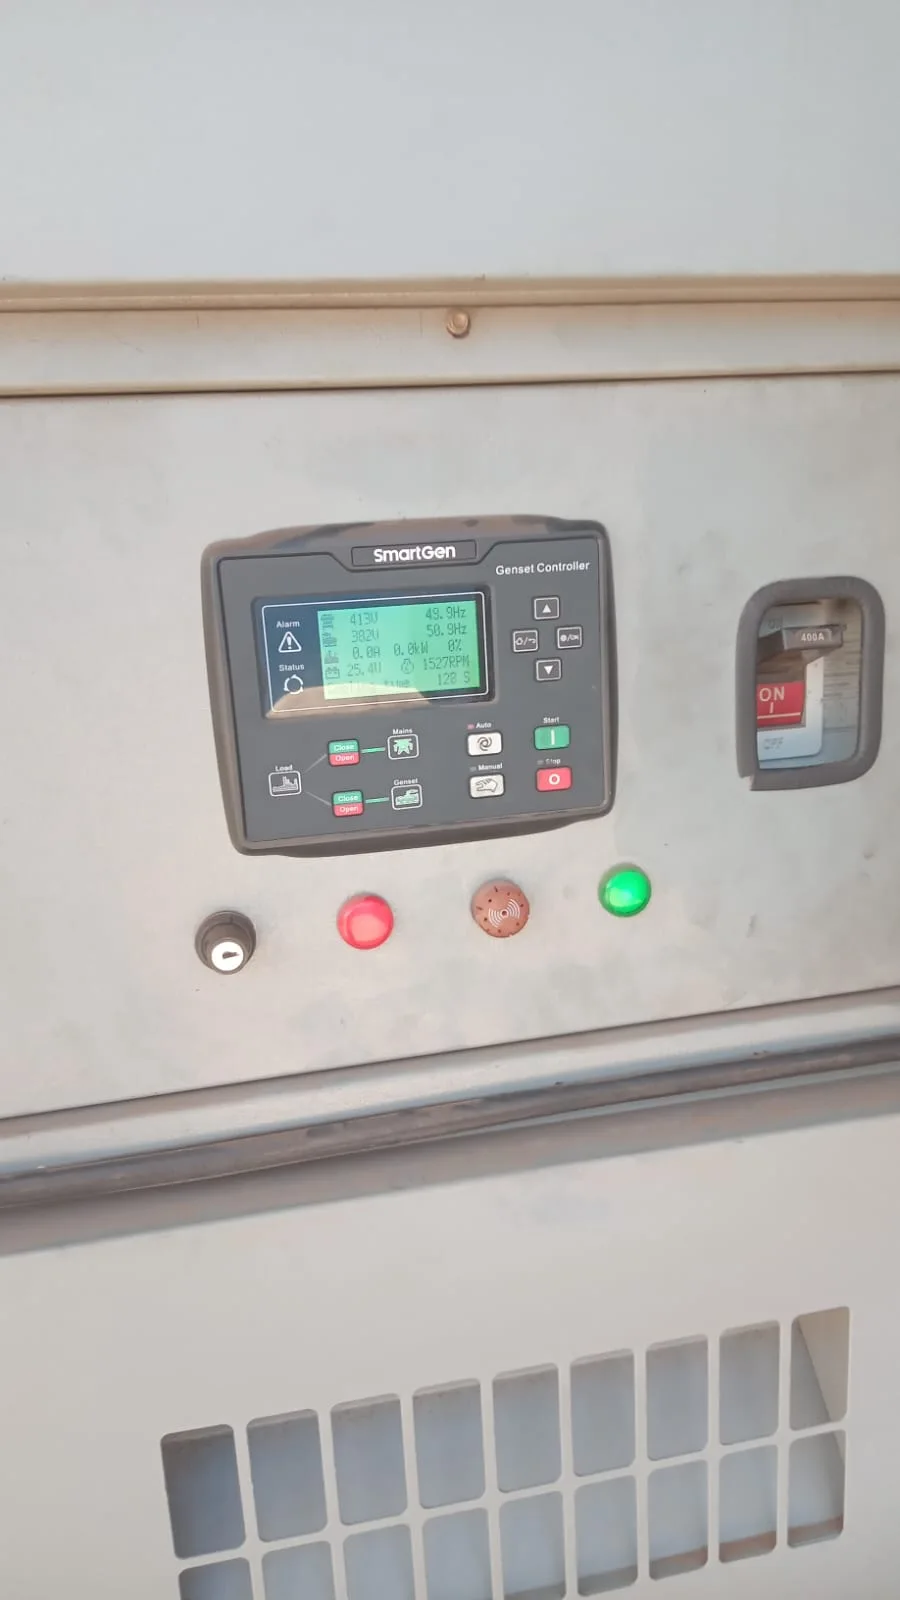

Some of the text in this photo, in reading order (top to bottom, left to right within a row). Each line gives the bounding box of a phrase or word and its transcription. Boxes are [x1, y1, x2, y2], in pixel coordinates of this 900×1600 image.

[373, 545, 456, 563] SmartGen
[495, 561, 590, 576] Genset Controller
[276, 620, 300, 628] Alarm
[800, 632, 825, 642] 400A
[279, 663, 305, 672] Status
[759, 686, 785, 702] ON
[335, 755, 355, 763] Open
[275, 764, 293, 772] Load
[478, 762, 503, 771] Manual
[393, 778, 419, 786] Genset
[339, 806, 359, 814] Open
